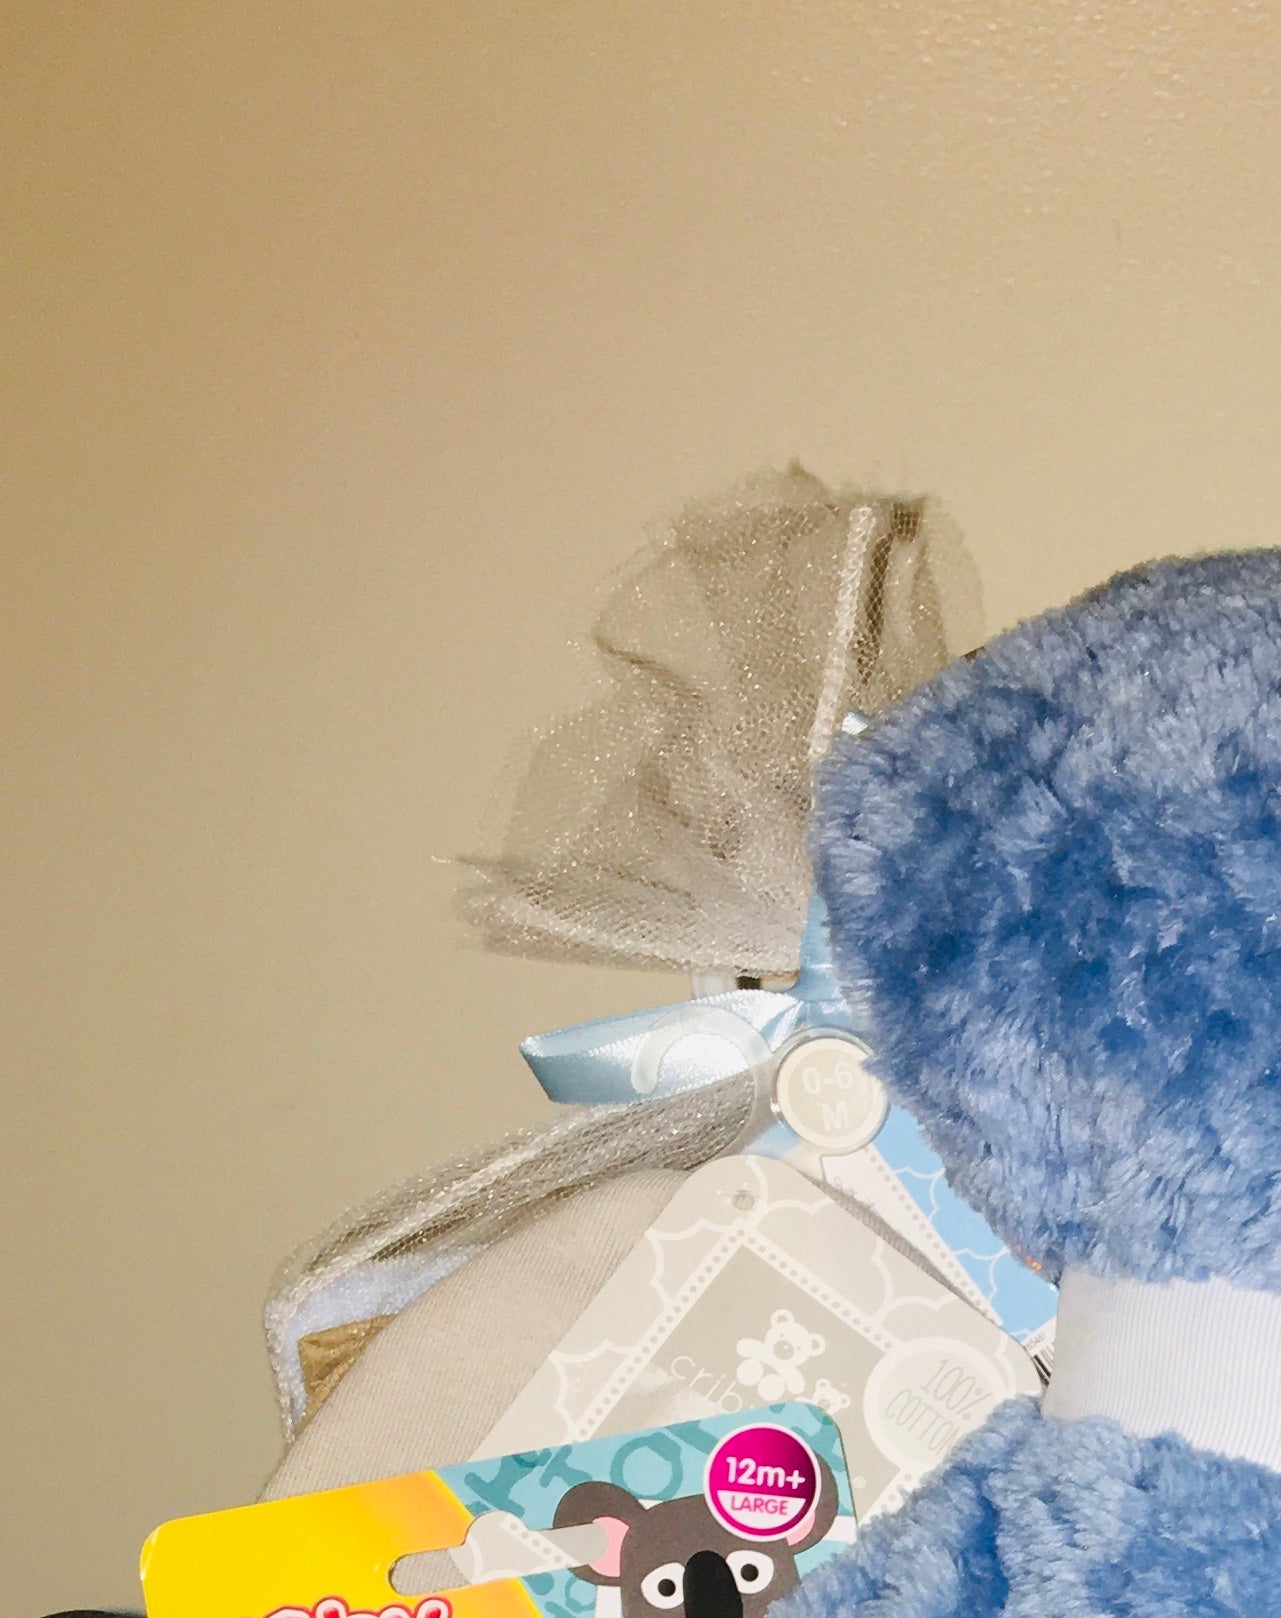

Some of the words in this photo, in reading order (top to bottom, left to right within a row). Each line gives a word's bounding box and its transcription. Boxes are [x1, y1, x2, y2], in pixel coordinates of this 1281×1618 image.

[920, 1358, 993, 1421] 100%
[725, 1456, 806, 1491] 12m+
[730, 1495, 789, 1516] LARGE
